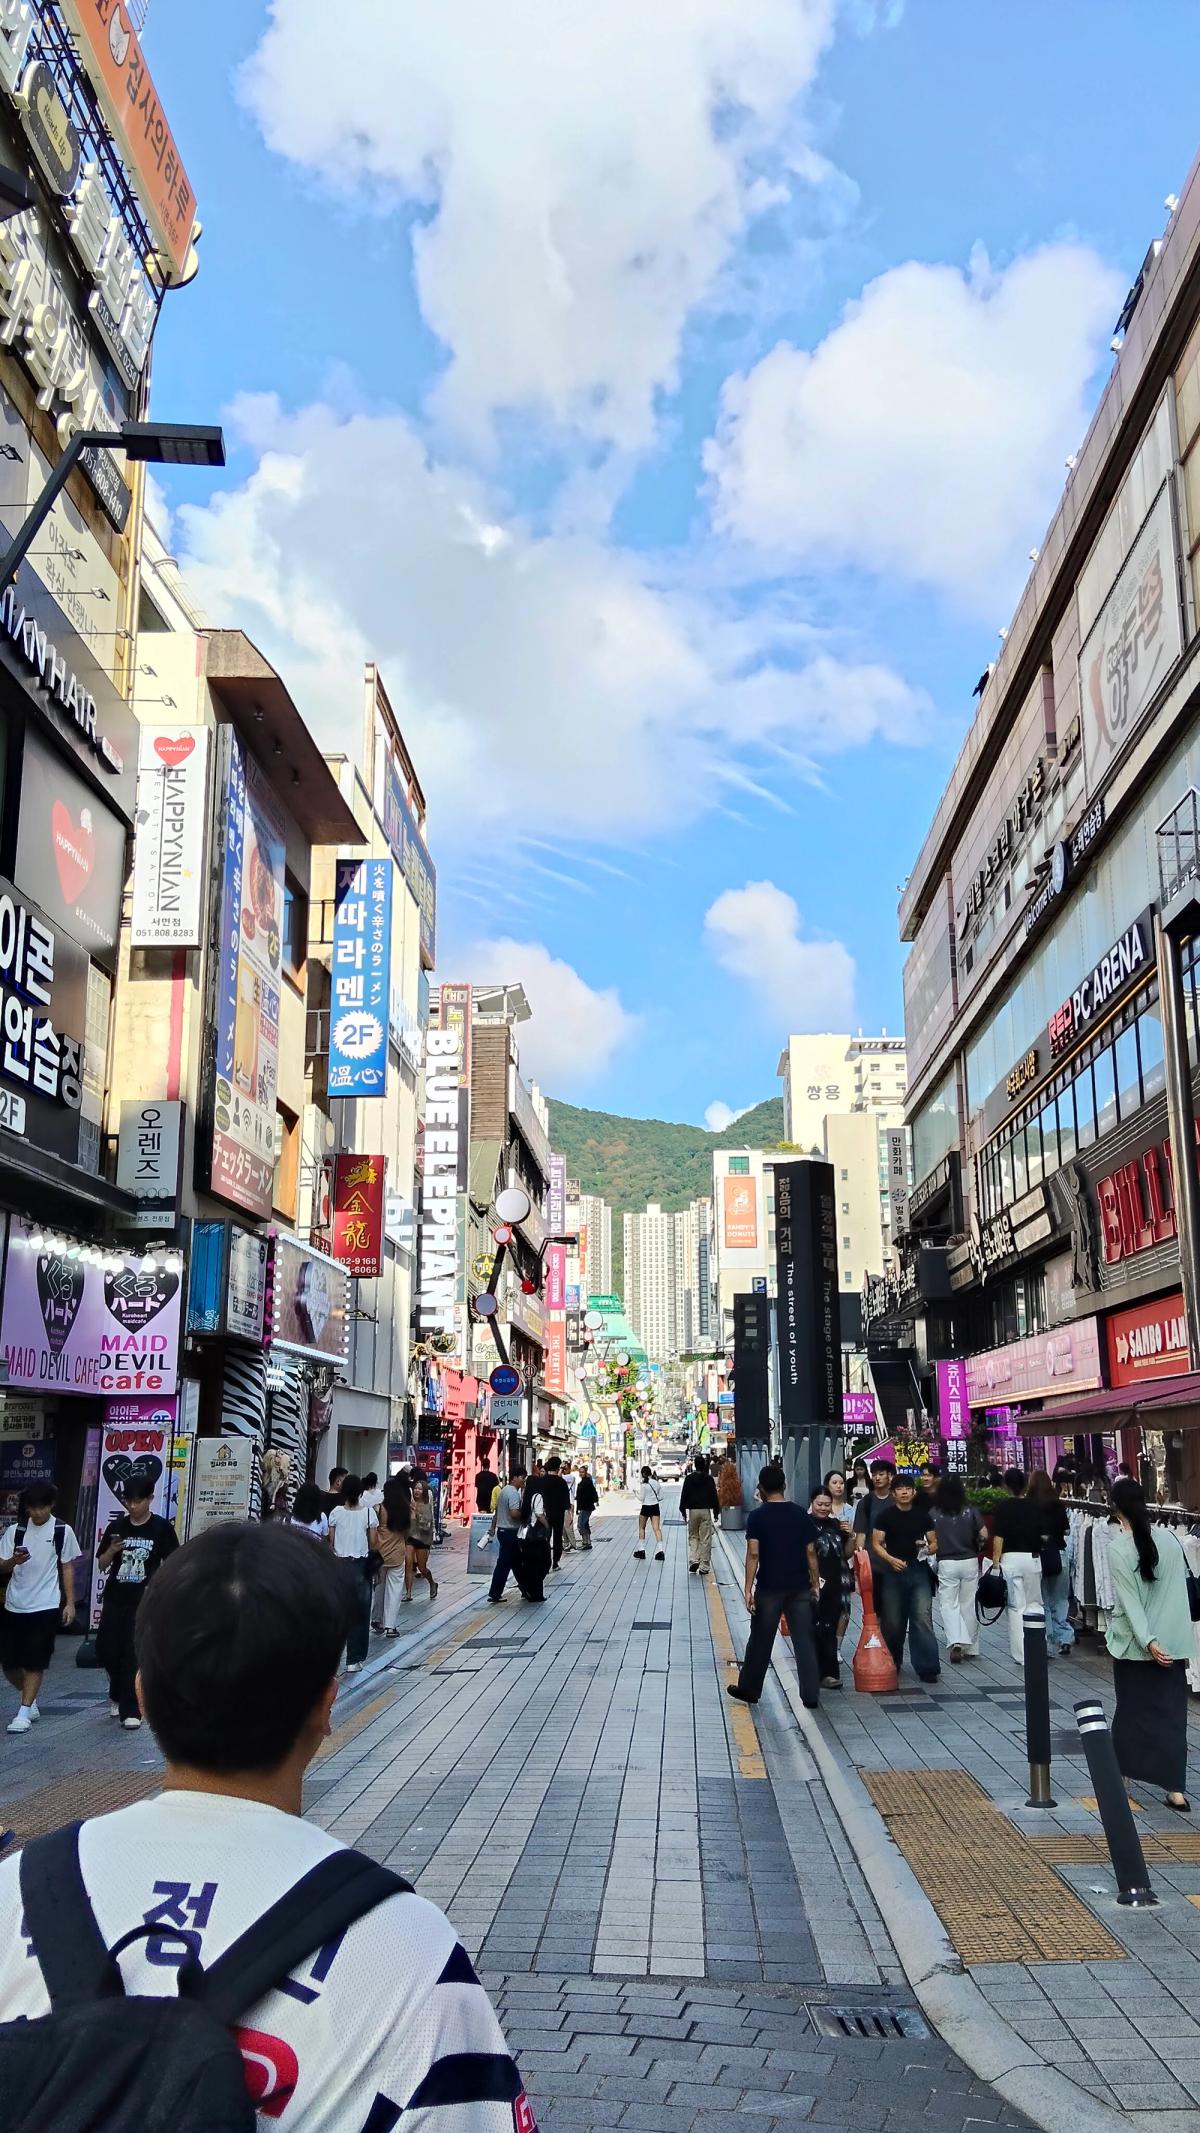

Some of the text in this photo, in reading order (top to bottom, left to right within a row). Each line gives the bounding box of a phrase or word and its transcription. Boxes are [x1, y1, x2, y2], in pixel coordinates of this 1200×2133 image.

[83, 449, 123, 519] 051-808-1410
[45, 646, 98, 743] HAIR
[55, 831, 89, 873] HAPPYNIAN
[160, 767, 188, 912] HAPPYNIAN
[151, 917, 182, 927] 서면점
[1023, 890, 1048, 936] Welcome
[135, 929, 194, 938] 051.808.8283
[335, 863, 369, 1008] 제따라멘
[1072, 923, 1145, 1030] PC ARENA
[342, 1024, 375, 1046] 2F
[1047, 997, 1073, 1046] RED
[0, 990, 86, 1110] 연습장
[0, 1089, 20, 1127] 2F
[806, 1085, 841, 1101] 쌍용
[134, 1108, 163, 1180] 오렌즈
[891, 1136, 904, 1176] 만화카페
[340, 1190, 375, 1251] 金龍
[778, 1177, 793, 1255] 젊음의 거리
[1096, 1137, 1178, 1266] BILL
[349, 1266, 377, 1274] -6066
[753, 1278, 765, 1292] P
[109, 1297, 162, 1312] ハート
[786, 1261, 799, 1385] The street of youth
[101, 1334, 168, 1352] MAID
[552, 1334, 561, 1350] THE
[823, 1280, 835, 1414] The stage of passion
[1128, 1316, 1188, 1358] SAMBO LAN
[5, 1344, 100, 1386] MAID DEVIL CAFE
[99, 1353, 171, 1371] DEVIL
[100, 1371, 163, 1390] cafe
[109, 1405, 139, 1416] 아이콘
[493, 1399, 520, 1408] 견인지역
[105, 1430, 165, 1452] OPEN
[864, 1424, 875, 1435] B1
[946, 1462, 968, 1473] 폰 B1
